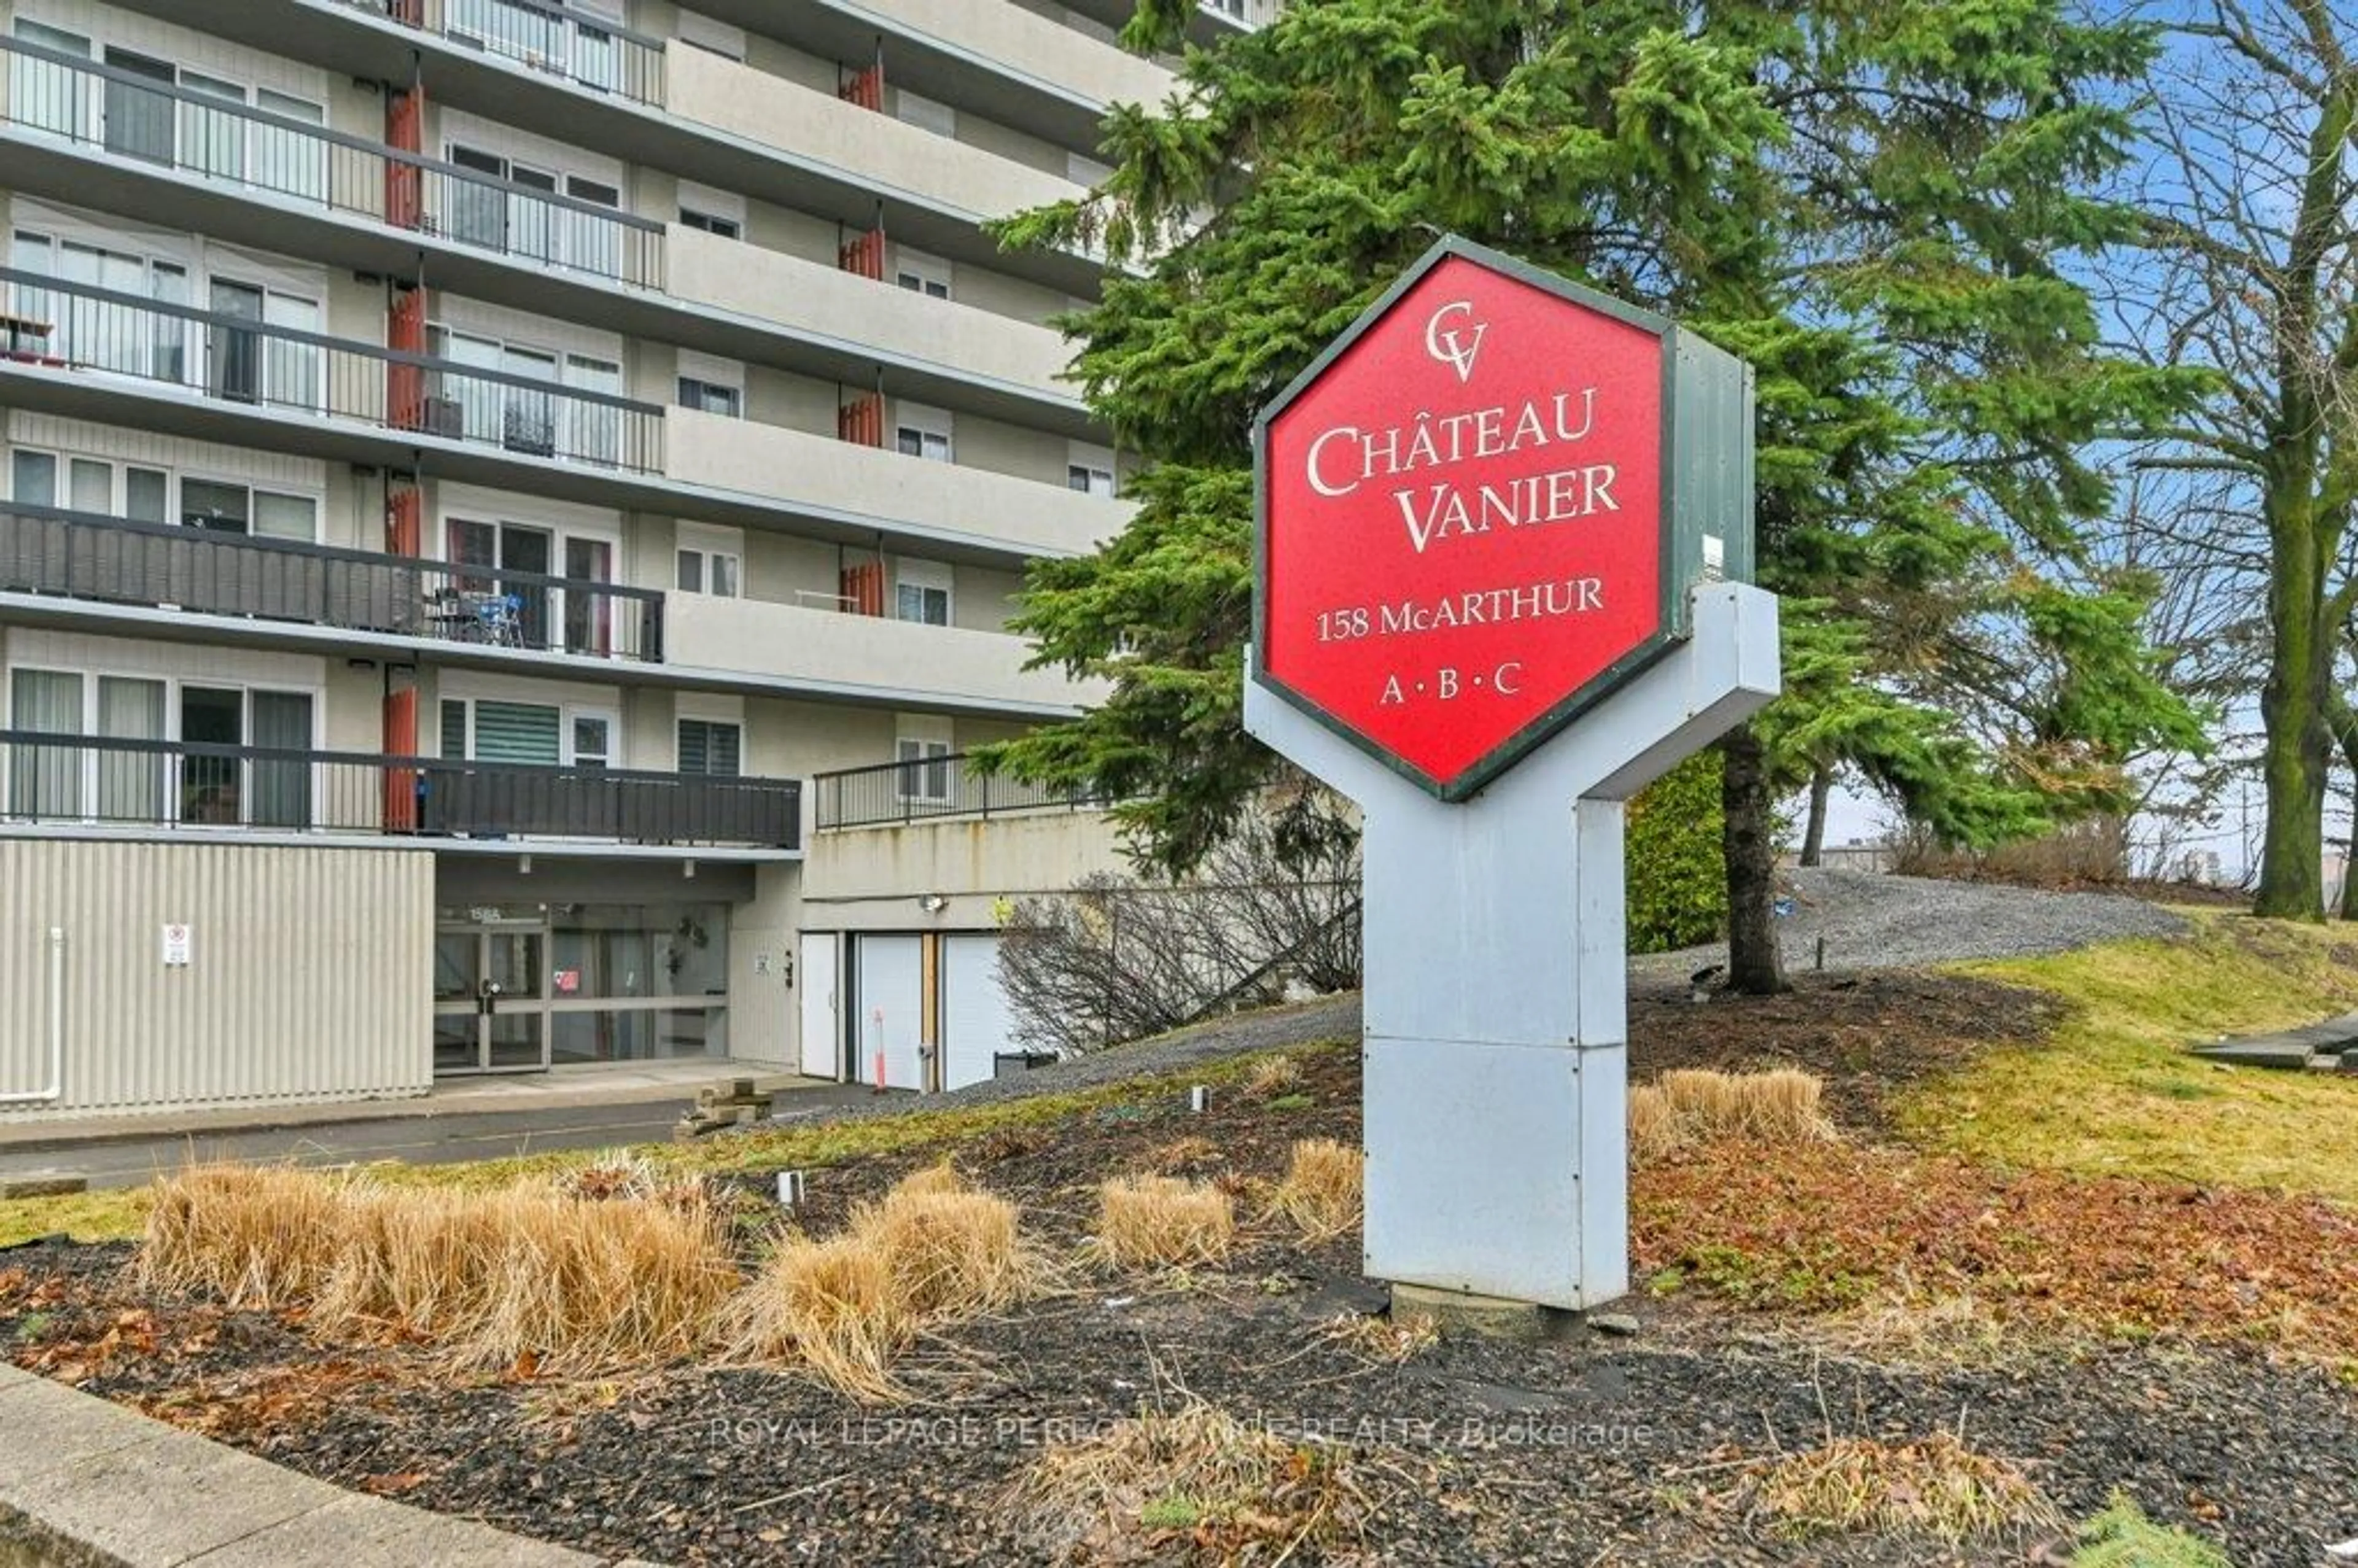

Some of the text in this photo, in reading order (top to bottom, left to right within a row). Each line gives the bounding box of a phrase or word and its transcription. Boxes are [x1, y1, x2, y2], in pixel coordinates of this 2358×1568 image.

[1306, 387, 1598, 497] CHÂTEAU
[1393, 464, 1621, 554] VANIER
[1317, 576, 1605, 642] 158 McARTHUR
